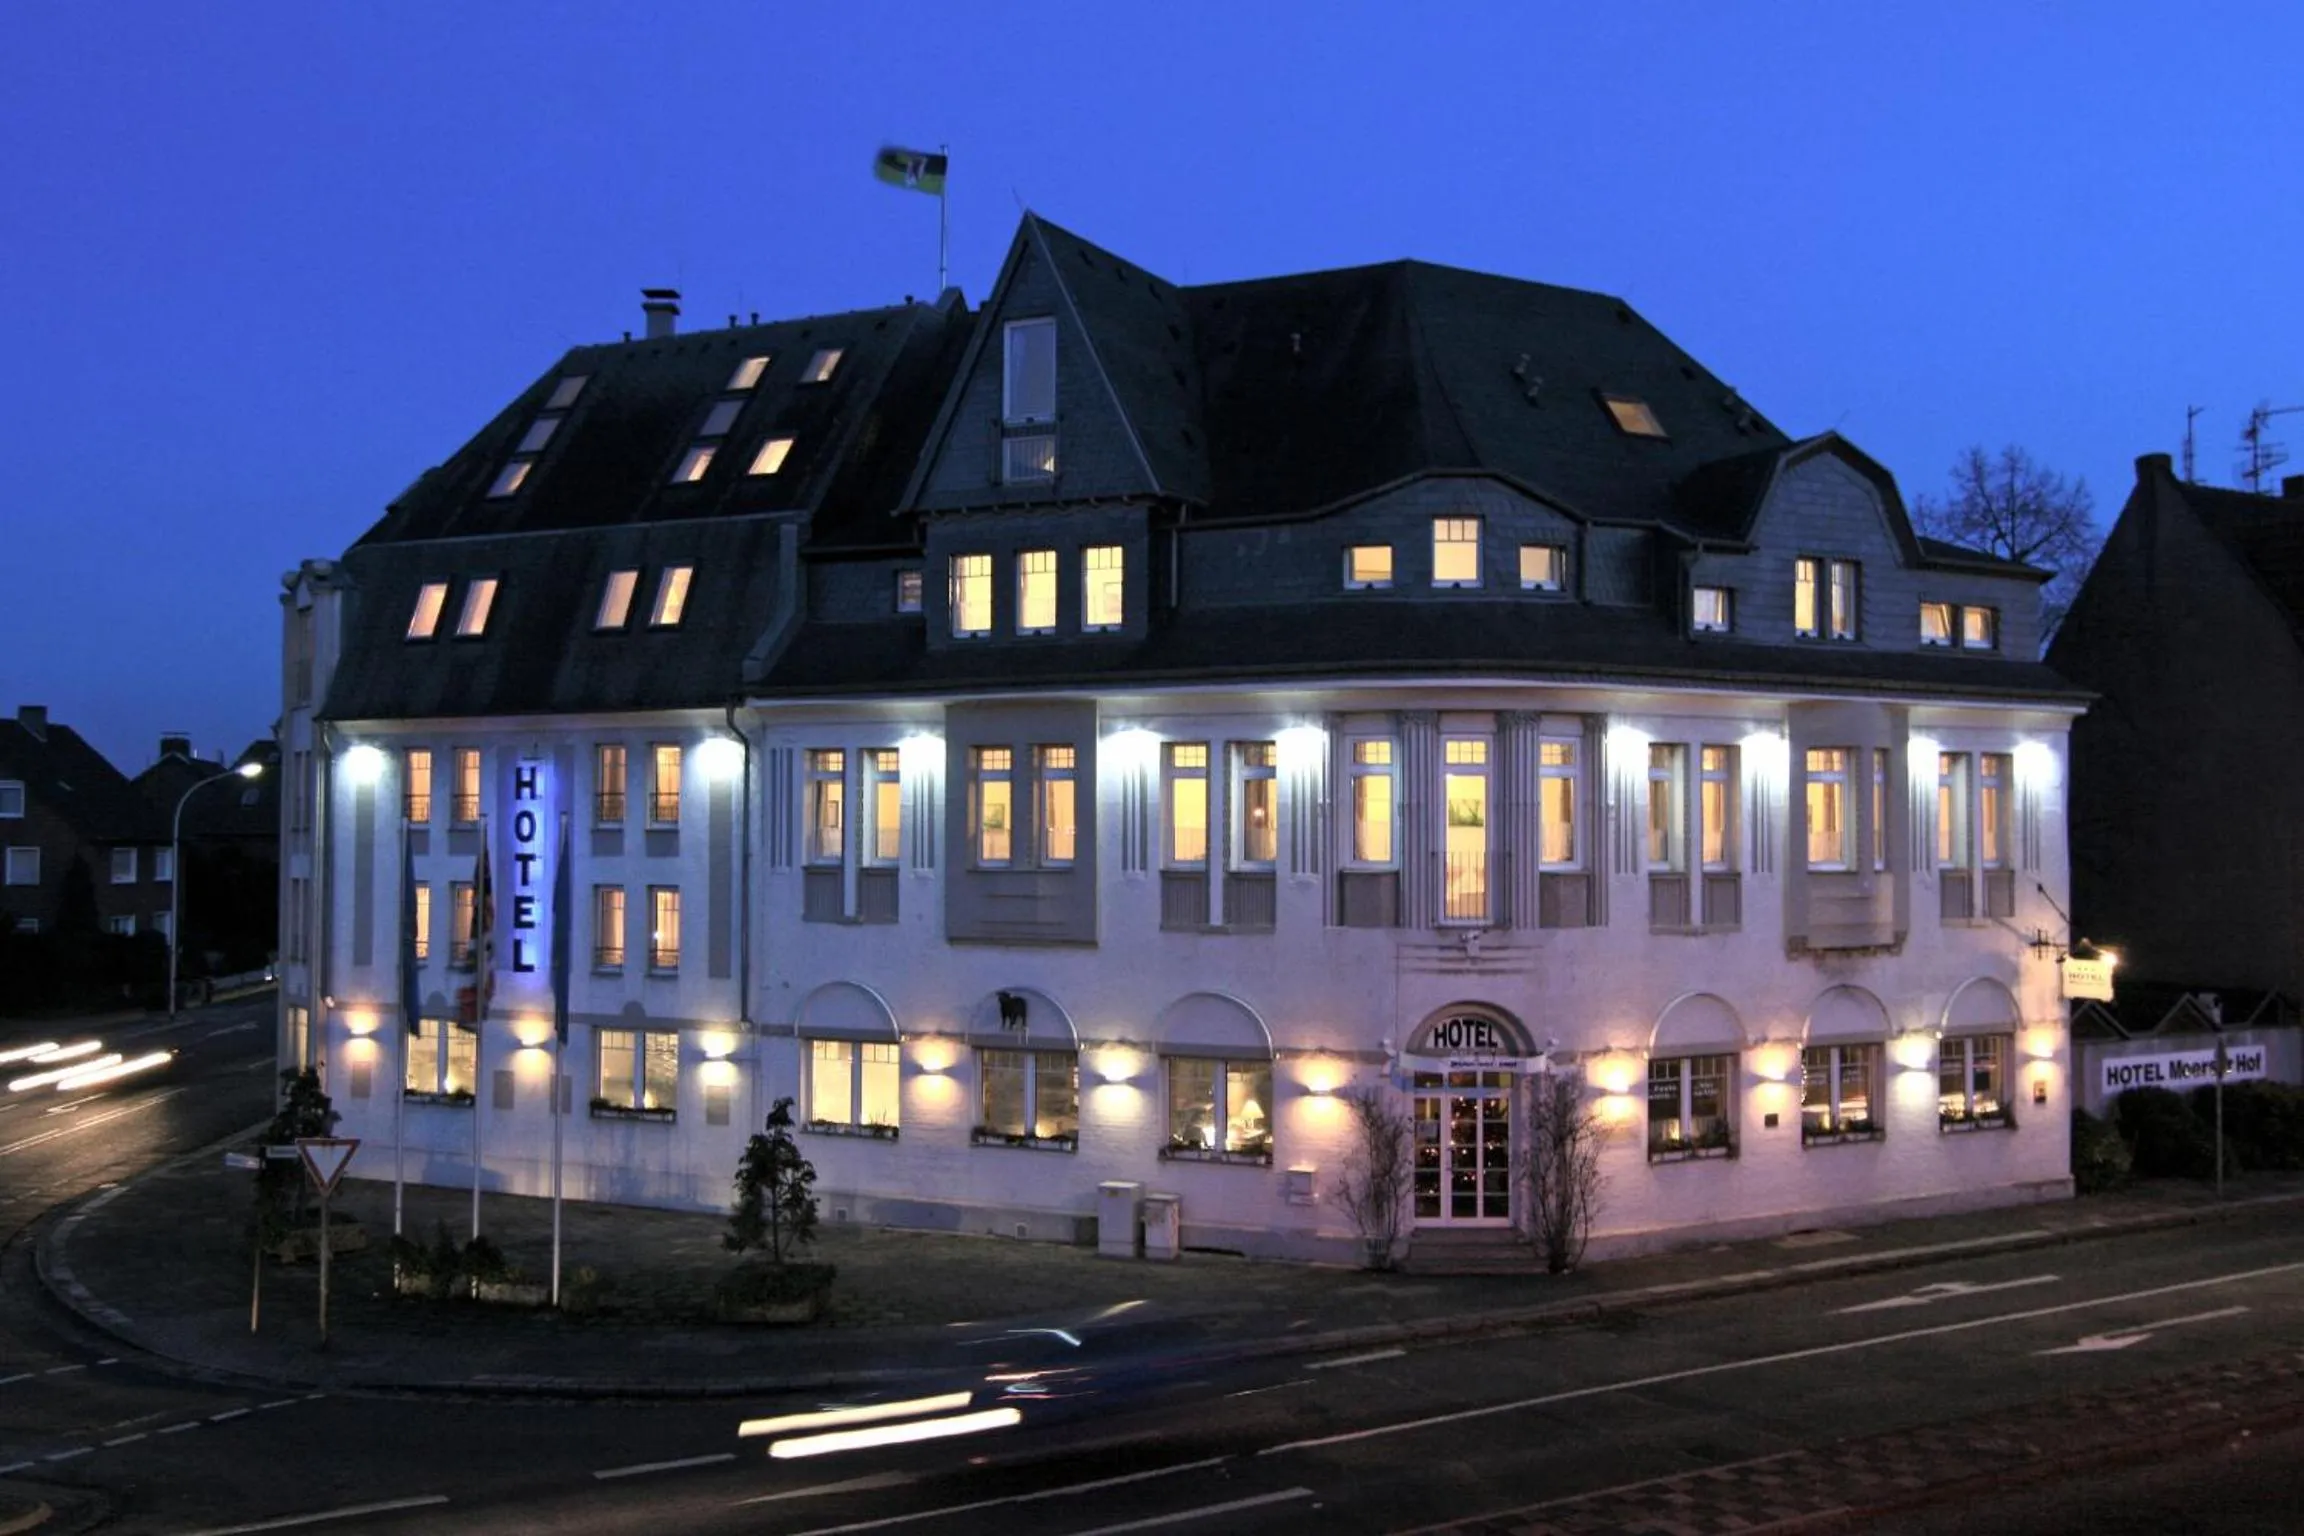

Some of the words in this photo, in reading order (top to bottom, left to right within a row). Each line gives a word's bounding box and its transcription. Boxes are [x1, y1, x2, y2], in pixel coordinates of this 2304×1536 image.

[513, 767, 537, 973] HOTEL
[1434, 1019, 1498, 1048] HOTEL
[2107, 1063, 2165, 1086] HOTEL
[2169, 1058, 2233, 1079] Moersr
[2236, 1051, 2261, 1073] Hof
